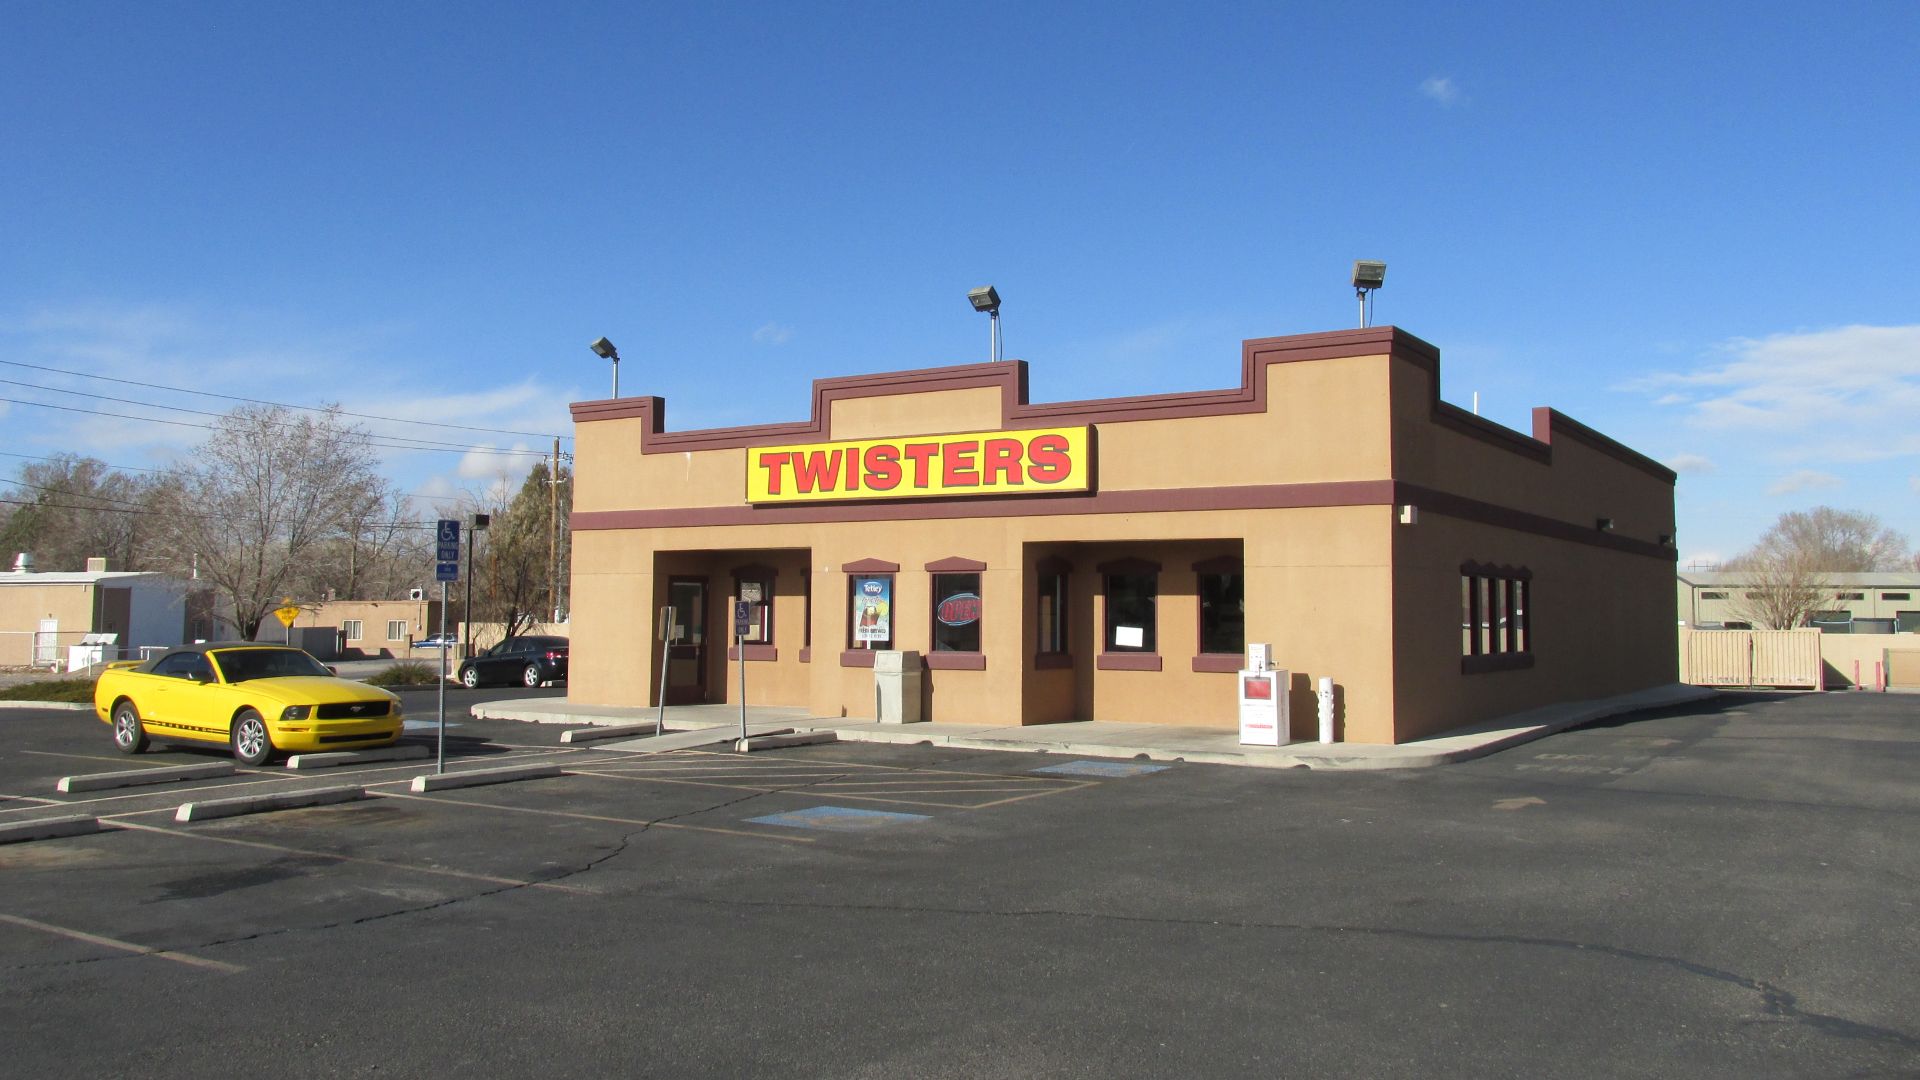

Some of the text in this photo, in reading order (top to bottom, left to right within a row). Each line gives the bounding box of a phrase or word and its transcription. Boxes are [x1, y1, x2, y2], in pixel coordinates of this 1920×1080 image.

[759, 434, 1073, 496] TWISTERS
[863, 584, 882, 593] Tetley
[943, 599, 981, 621] OPEN
[161, 722, 207, 731] MUSTANG
